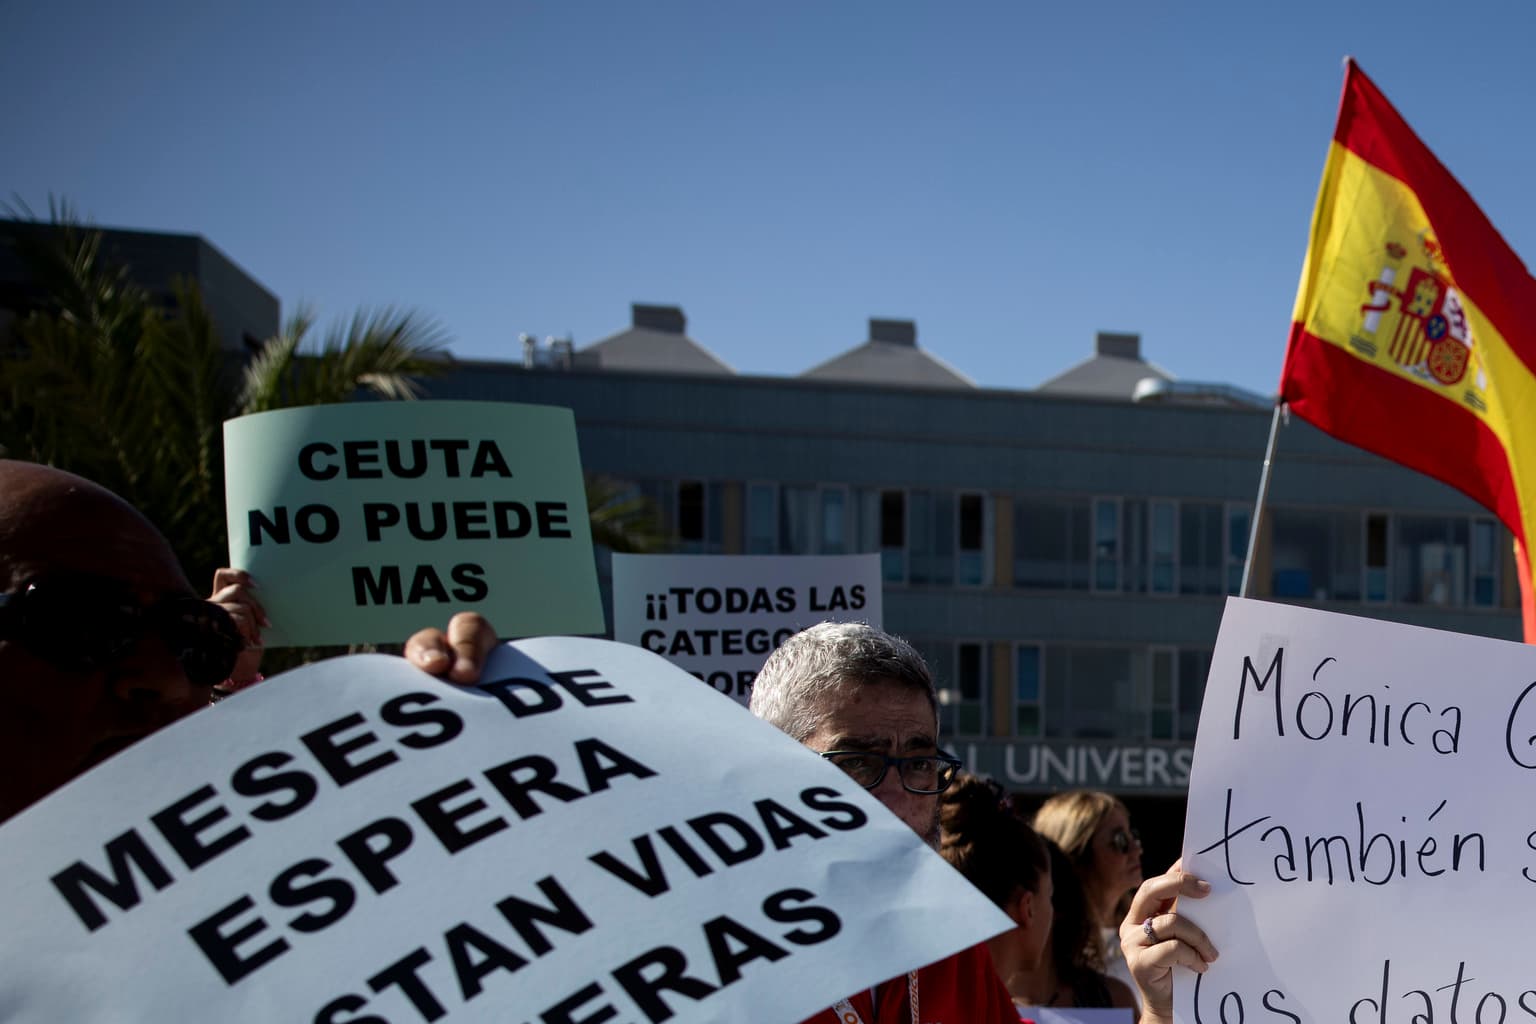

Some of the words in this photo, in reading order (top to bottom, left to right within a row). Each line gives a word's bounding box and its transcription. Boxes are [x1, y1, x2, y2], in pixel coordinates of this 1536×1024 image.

[297, 438, 513, 482] CEUTA
[248, 502, 341, 546] NO
[362, 501, 572, 543] PUEDE
[350, 563, 489, 607] MAS
[645, 586, 797, 620] ¡¡TODAS
[808, 584, 866, 612] LAS
[1233, 647, 1462, 755] Mónica
[49, 690, 465, 932] MESES
[478, 669, 635, 719] DE
[589, 787, 868, 897] VIDAS
[1197, 789, 1485, 886] también
[187, 738, 657, 986] ESPERA
